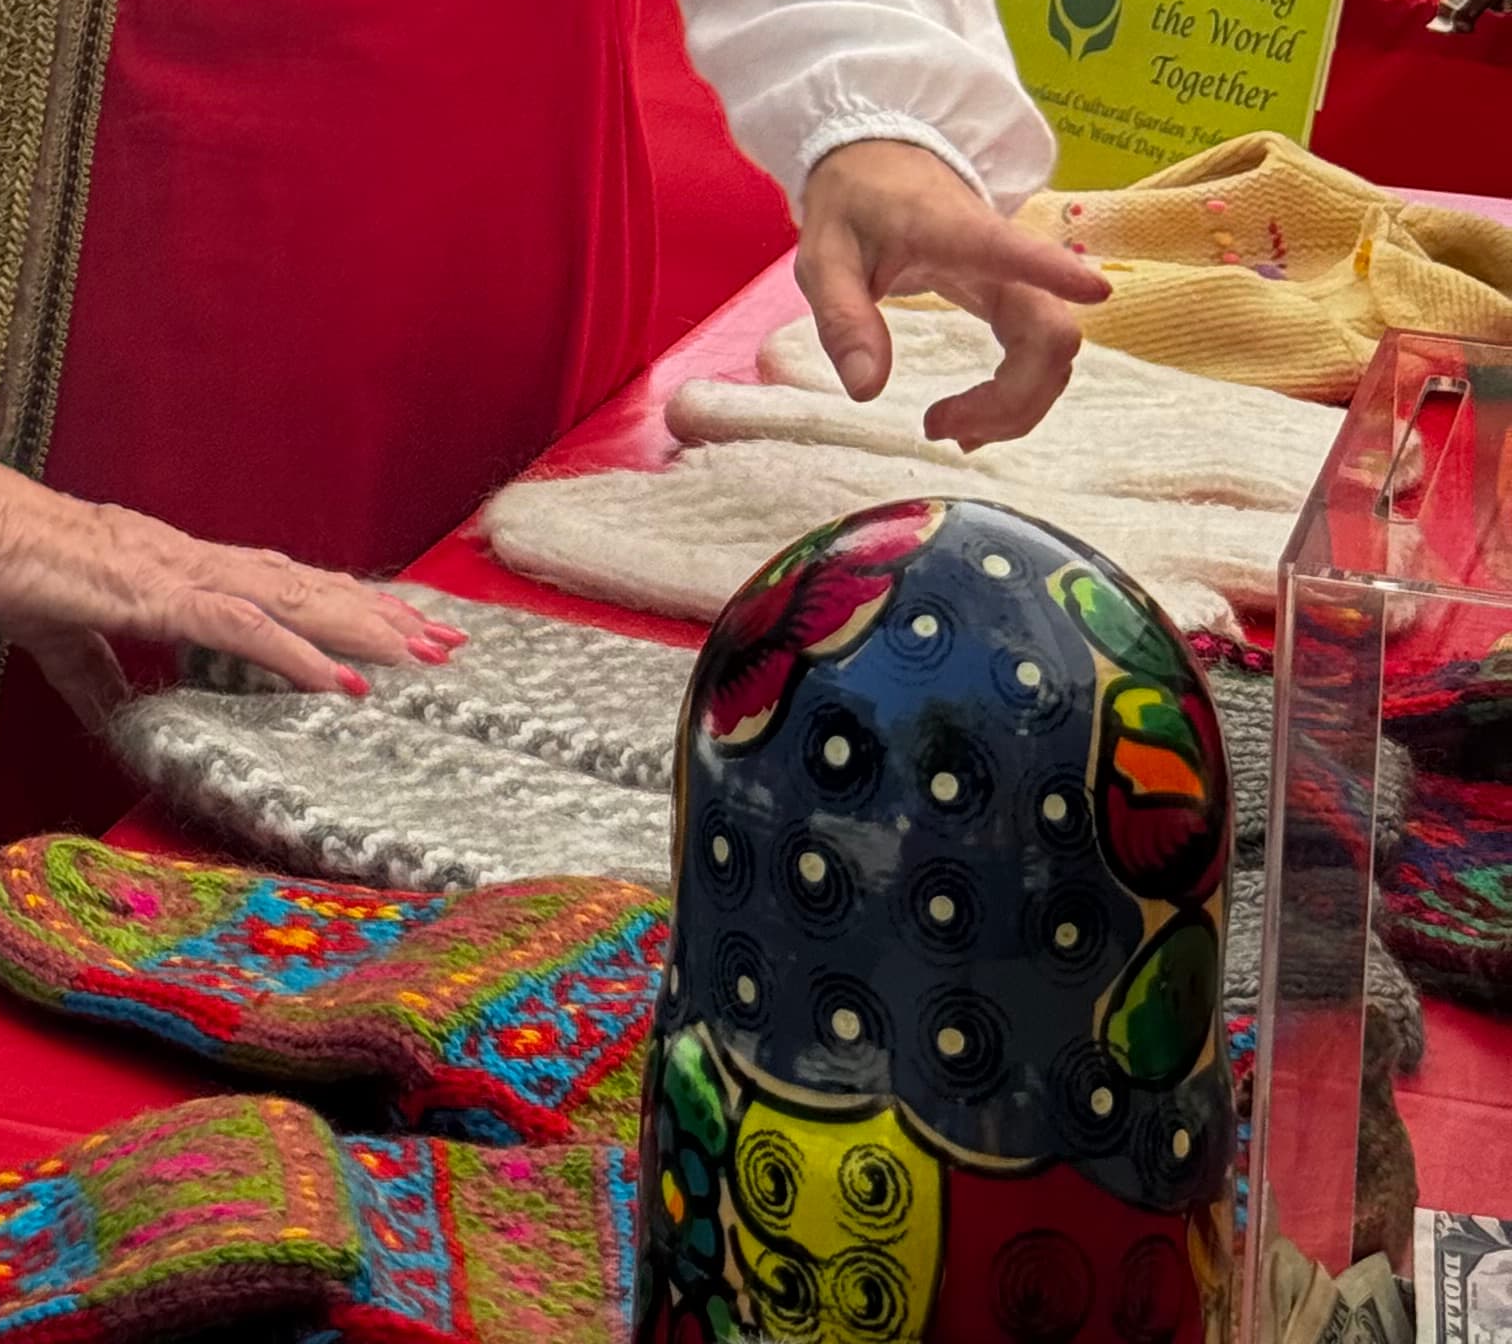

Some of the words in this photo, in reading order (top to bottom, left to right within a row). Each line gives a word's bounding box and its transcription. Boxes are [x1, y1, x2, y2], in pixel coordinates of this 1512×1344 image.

[1150, 0, 1195, 38] the
[1207, 8, 1307, 63] World
[1150, 55, 1278, 111] Together
[1056, 115, 1085, 137] One
[1090, 121, 1135, 150] World
[1133, 137, 1165, 164] Day
[1073, 92, 1135, 123] Cultural
[1133, 110, 1185, 138] Garden
